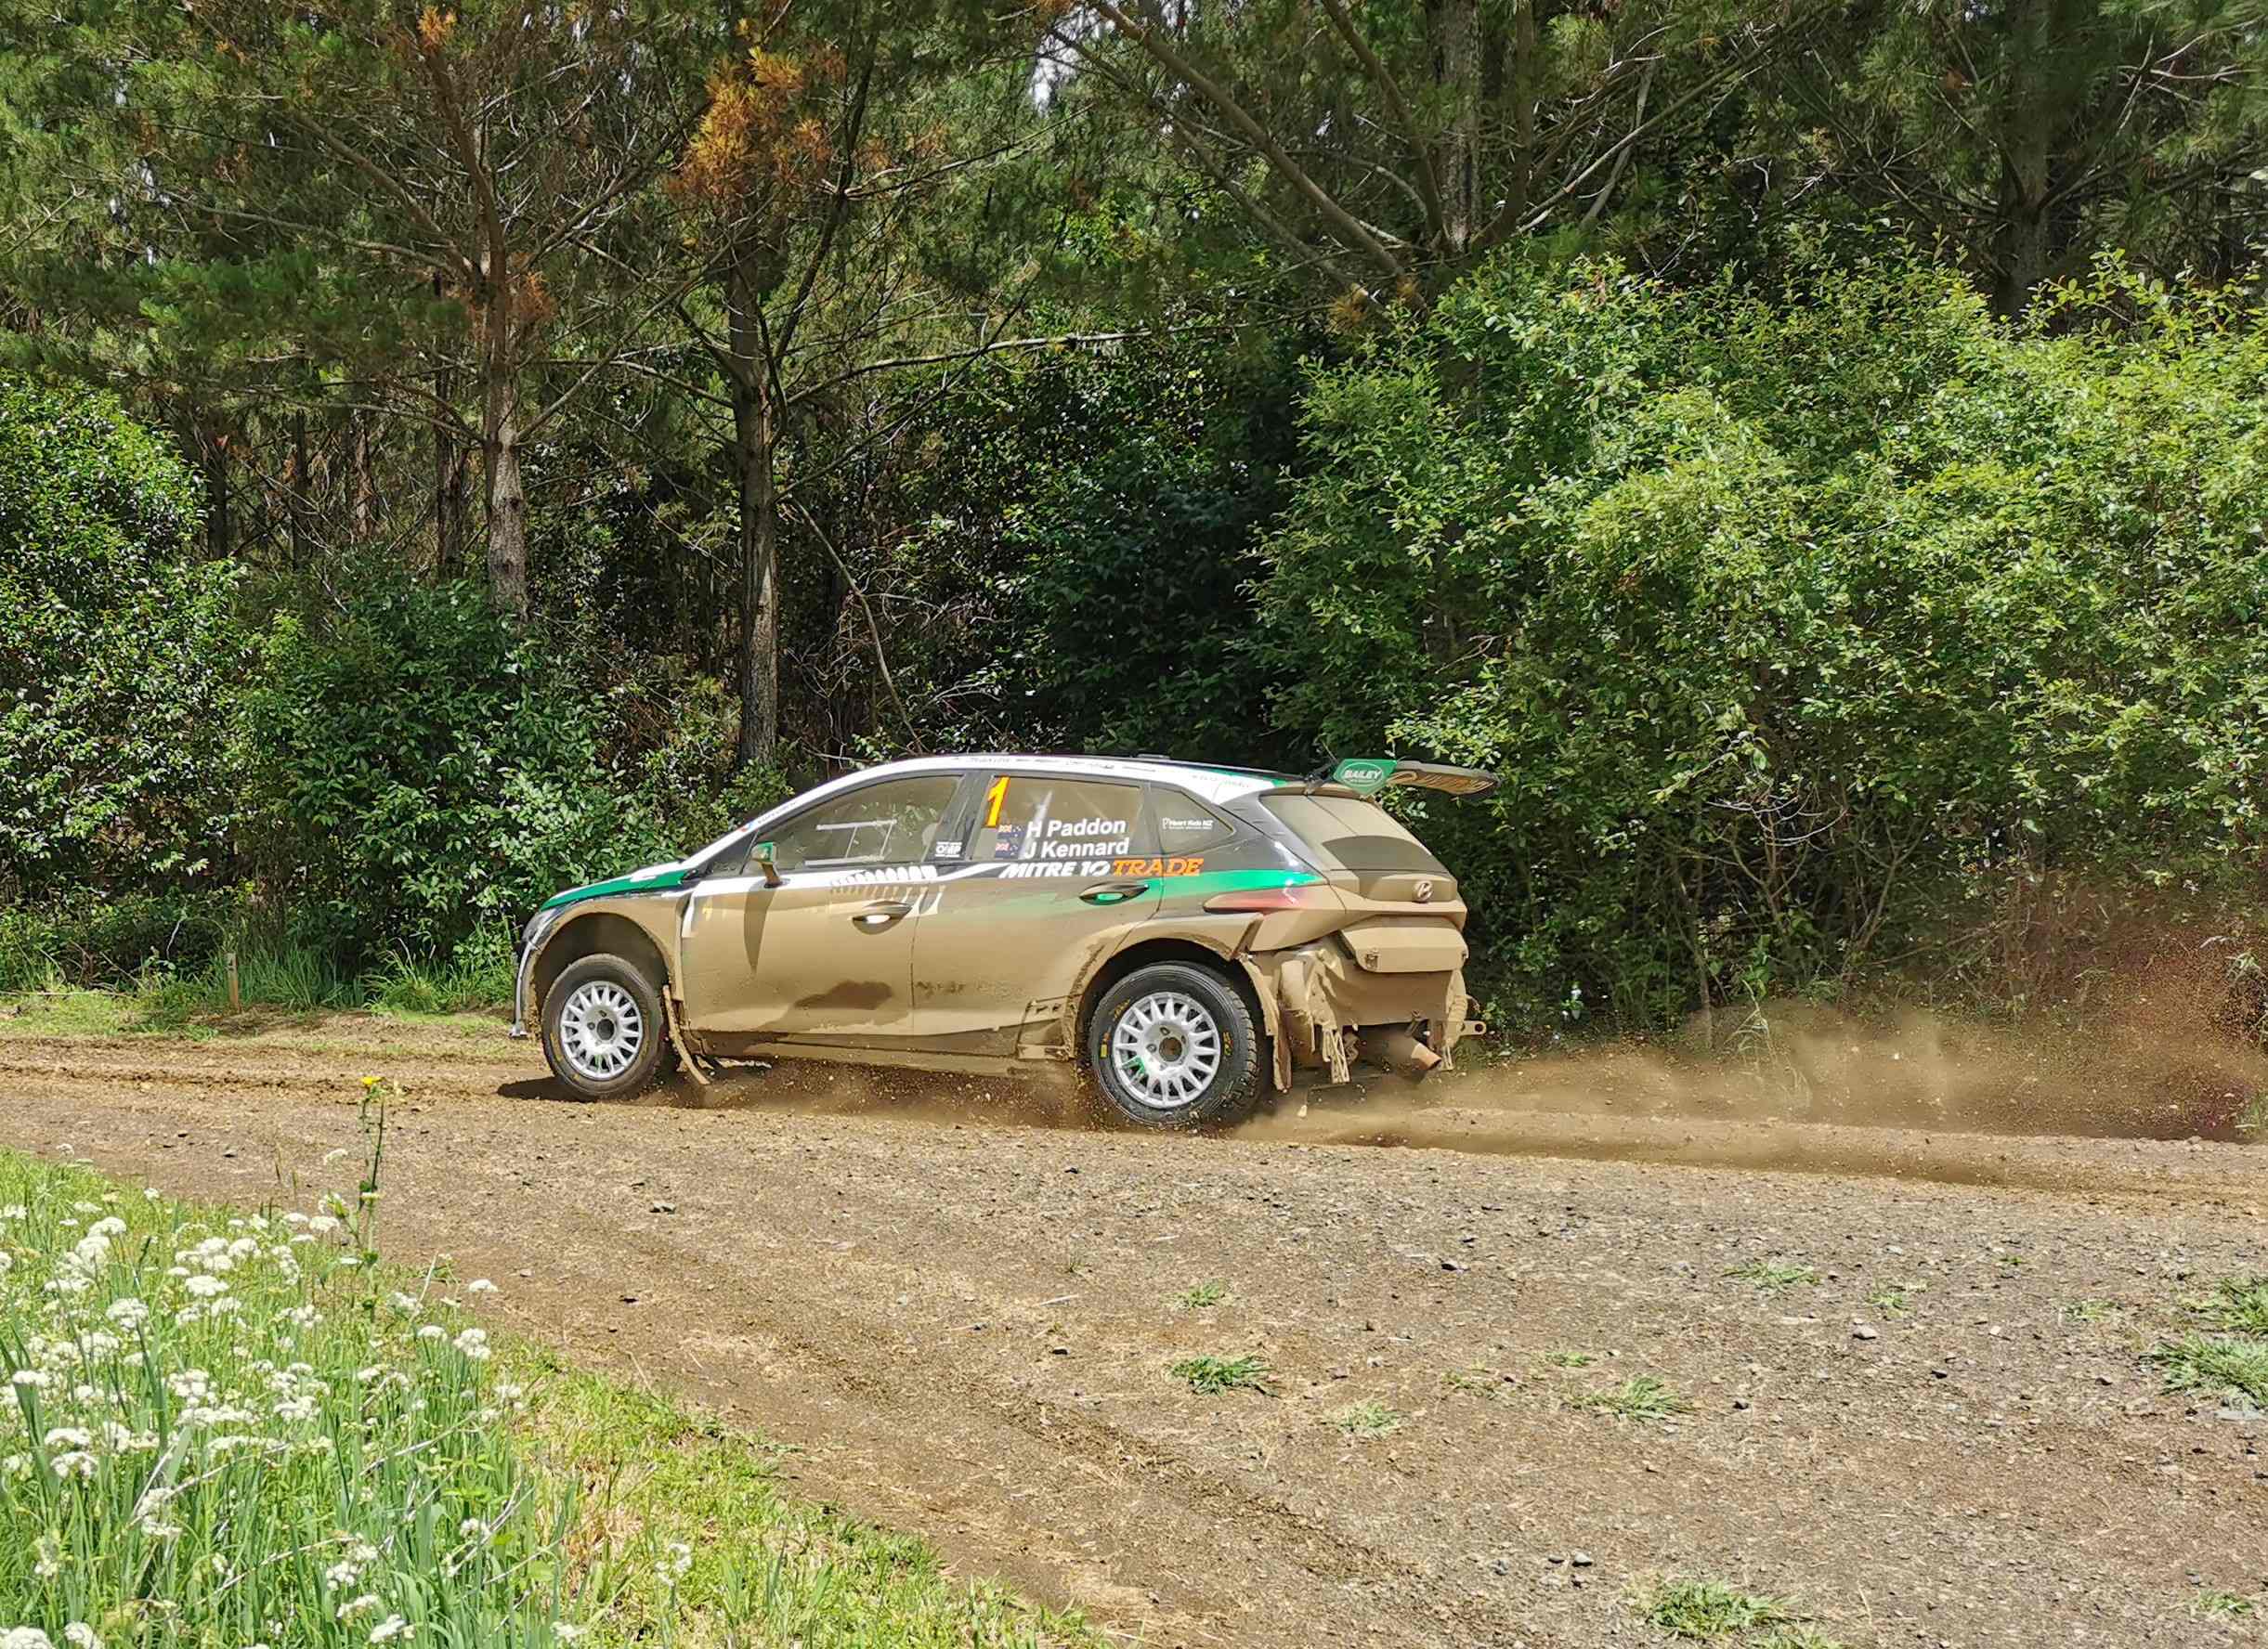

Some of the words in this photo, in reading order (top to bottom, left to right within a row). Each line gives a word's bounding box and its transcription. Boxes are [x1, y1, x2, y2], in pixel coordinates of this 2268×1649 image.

[1344, 770, 1382, 780] BAILEY
[986, 776, 1010, 827] 1
[1026, 820, 1043, 837] H
[1047, 818, 1127, 837] Paddon
[1023, 841, 1037, 859] J
[1041, 837, 1130, 858] Kennard
[998, 861, 1075, 878] MITRE
[1079, 861, 1111, 876] 10
[1114, 858, 1205, 876] TRADE
